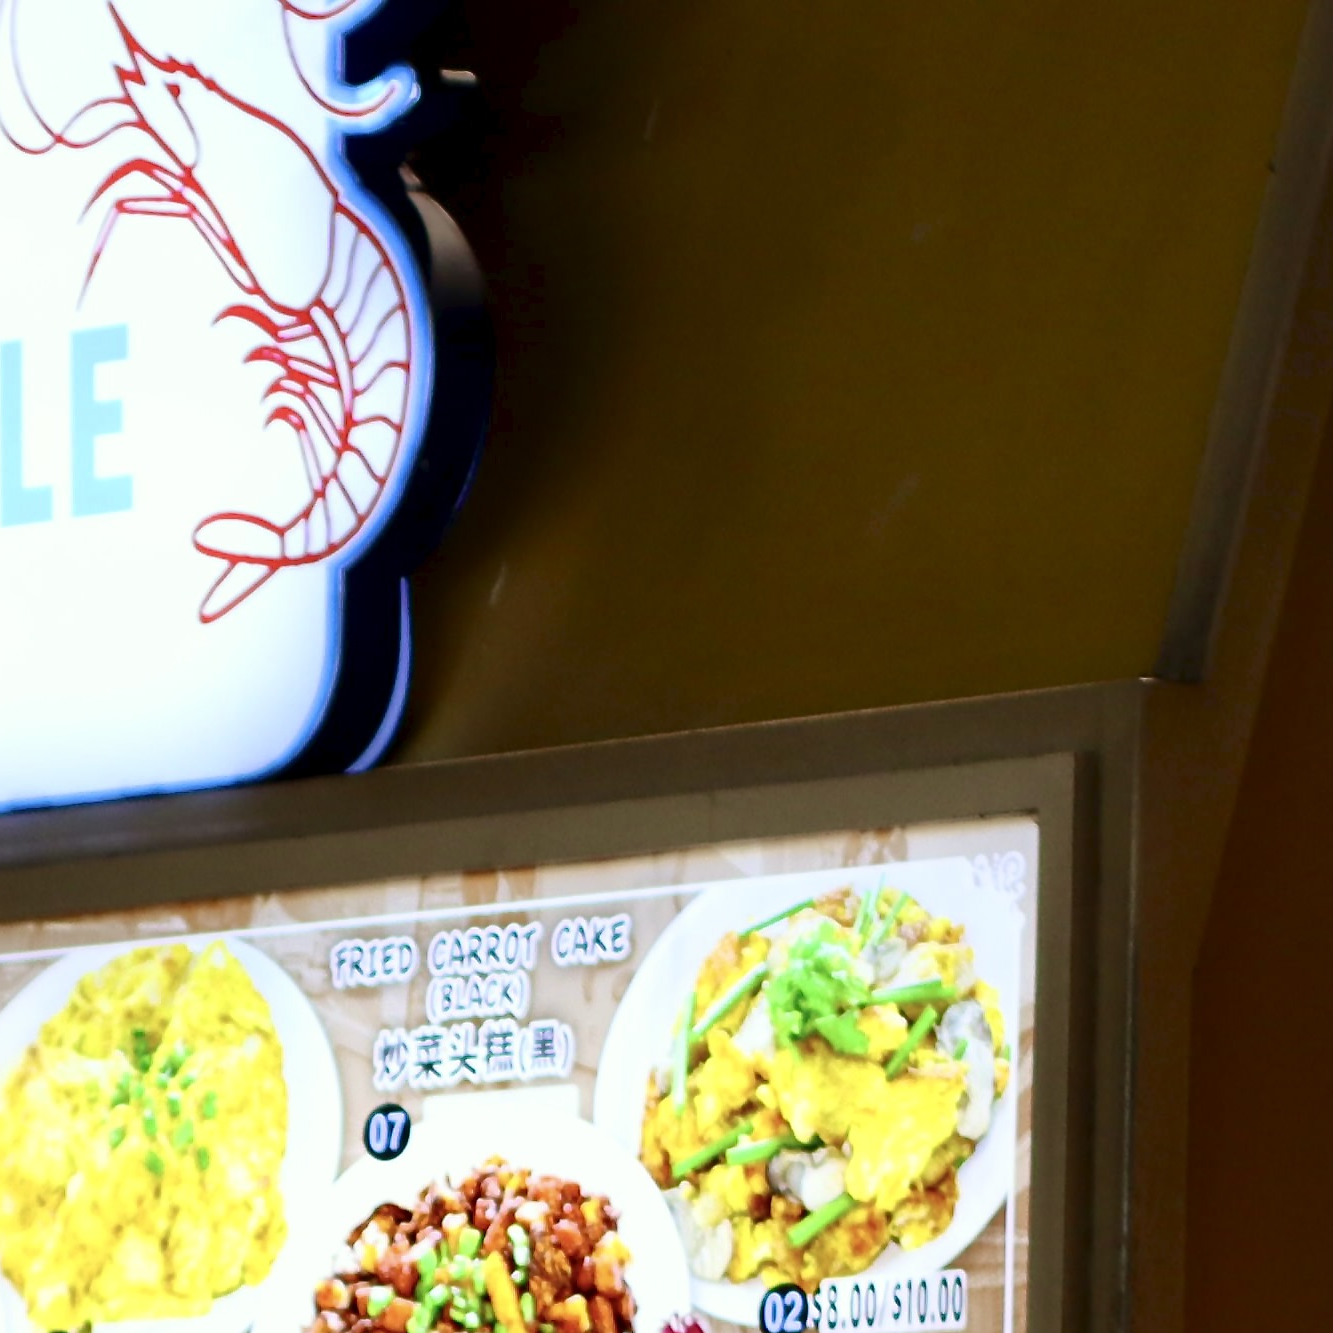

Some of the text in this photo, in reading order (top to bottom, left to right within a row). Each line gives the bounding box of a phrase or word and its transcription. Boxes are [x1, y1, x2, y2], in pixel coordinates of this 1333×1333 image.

[333, 917, 629, 984] FRIED CARROT CAKE
[427, 970, 530, 1018] (BLACK)
[368, 1111, 407, 1154] 07
[762, 1290, 805, 1333] 02
